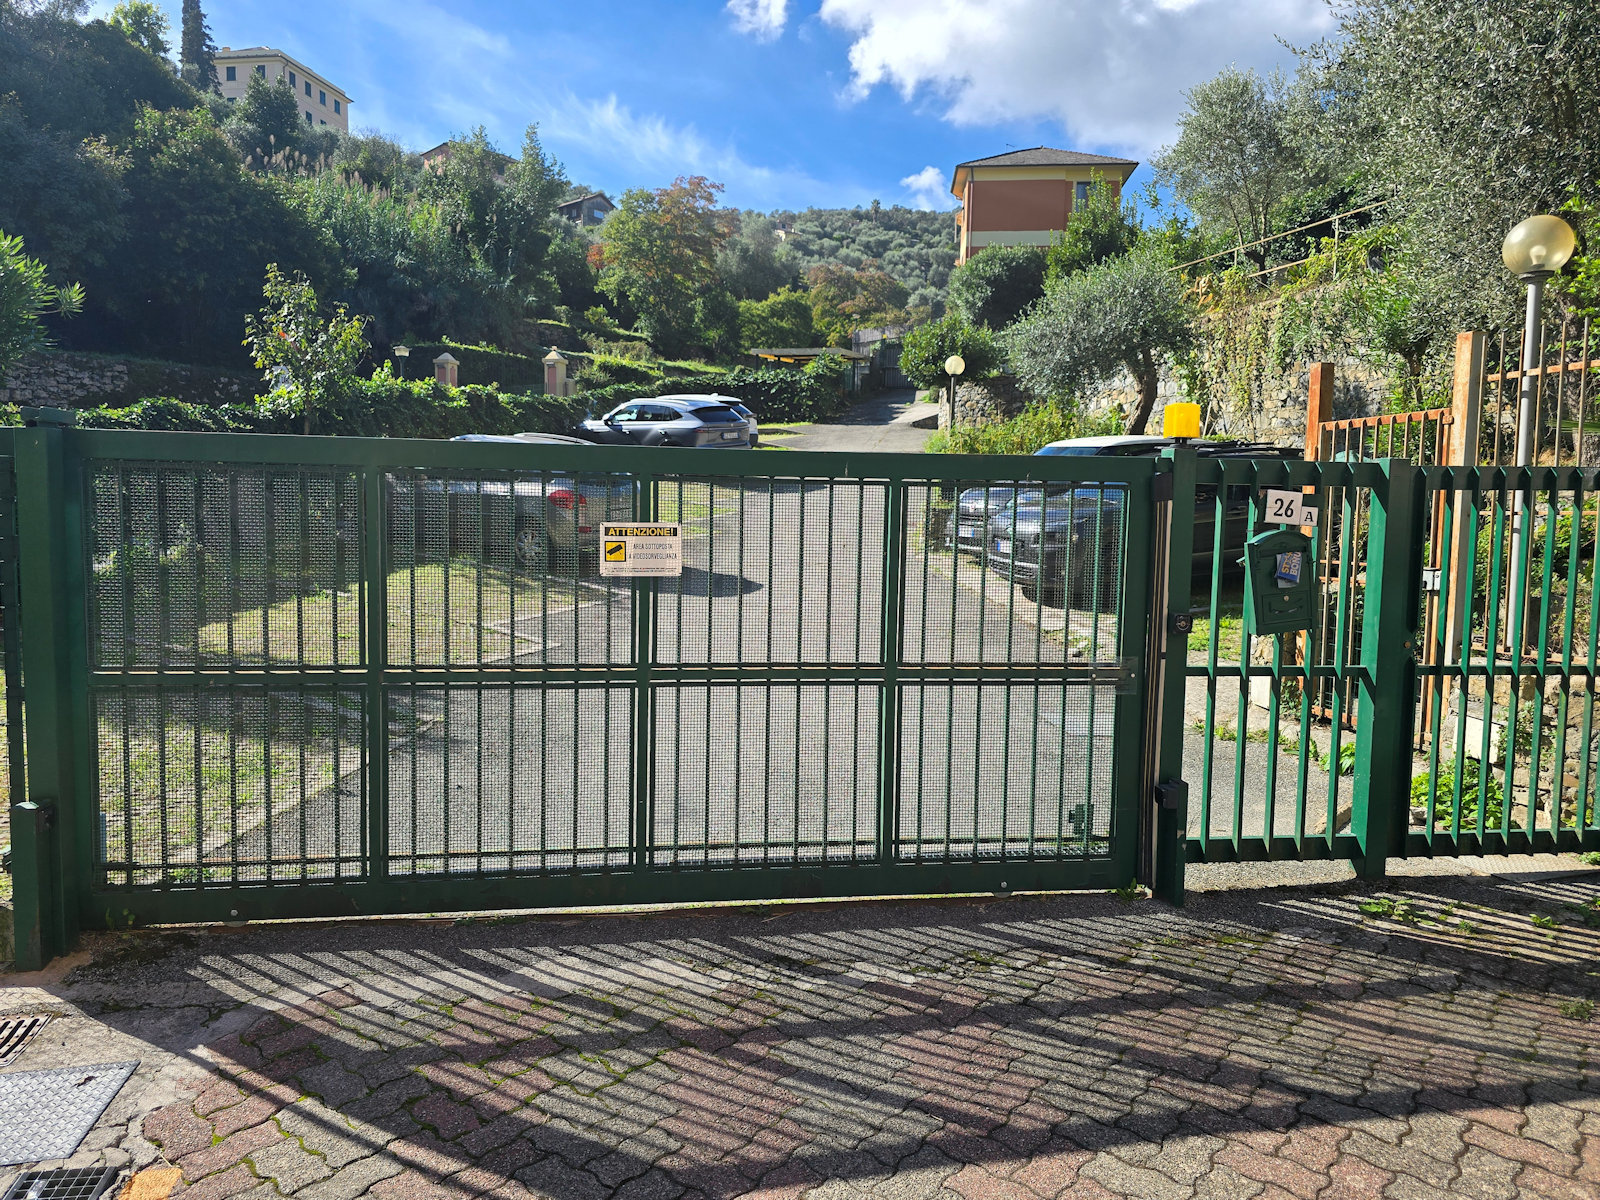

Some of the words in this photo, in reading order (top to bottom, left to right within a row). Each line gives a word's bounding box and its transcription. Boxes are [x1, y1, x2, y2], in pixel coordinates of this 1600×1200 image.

[1273, 498, 1295, 518] 26
[1304, 511, 1314, 522] A
[608, 527, 674, 536] ATTENZIONE!
